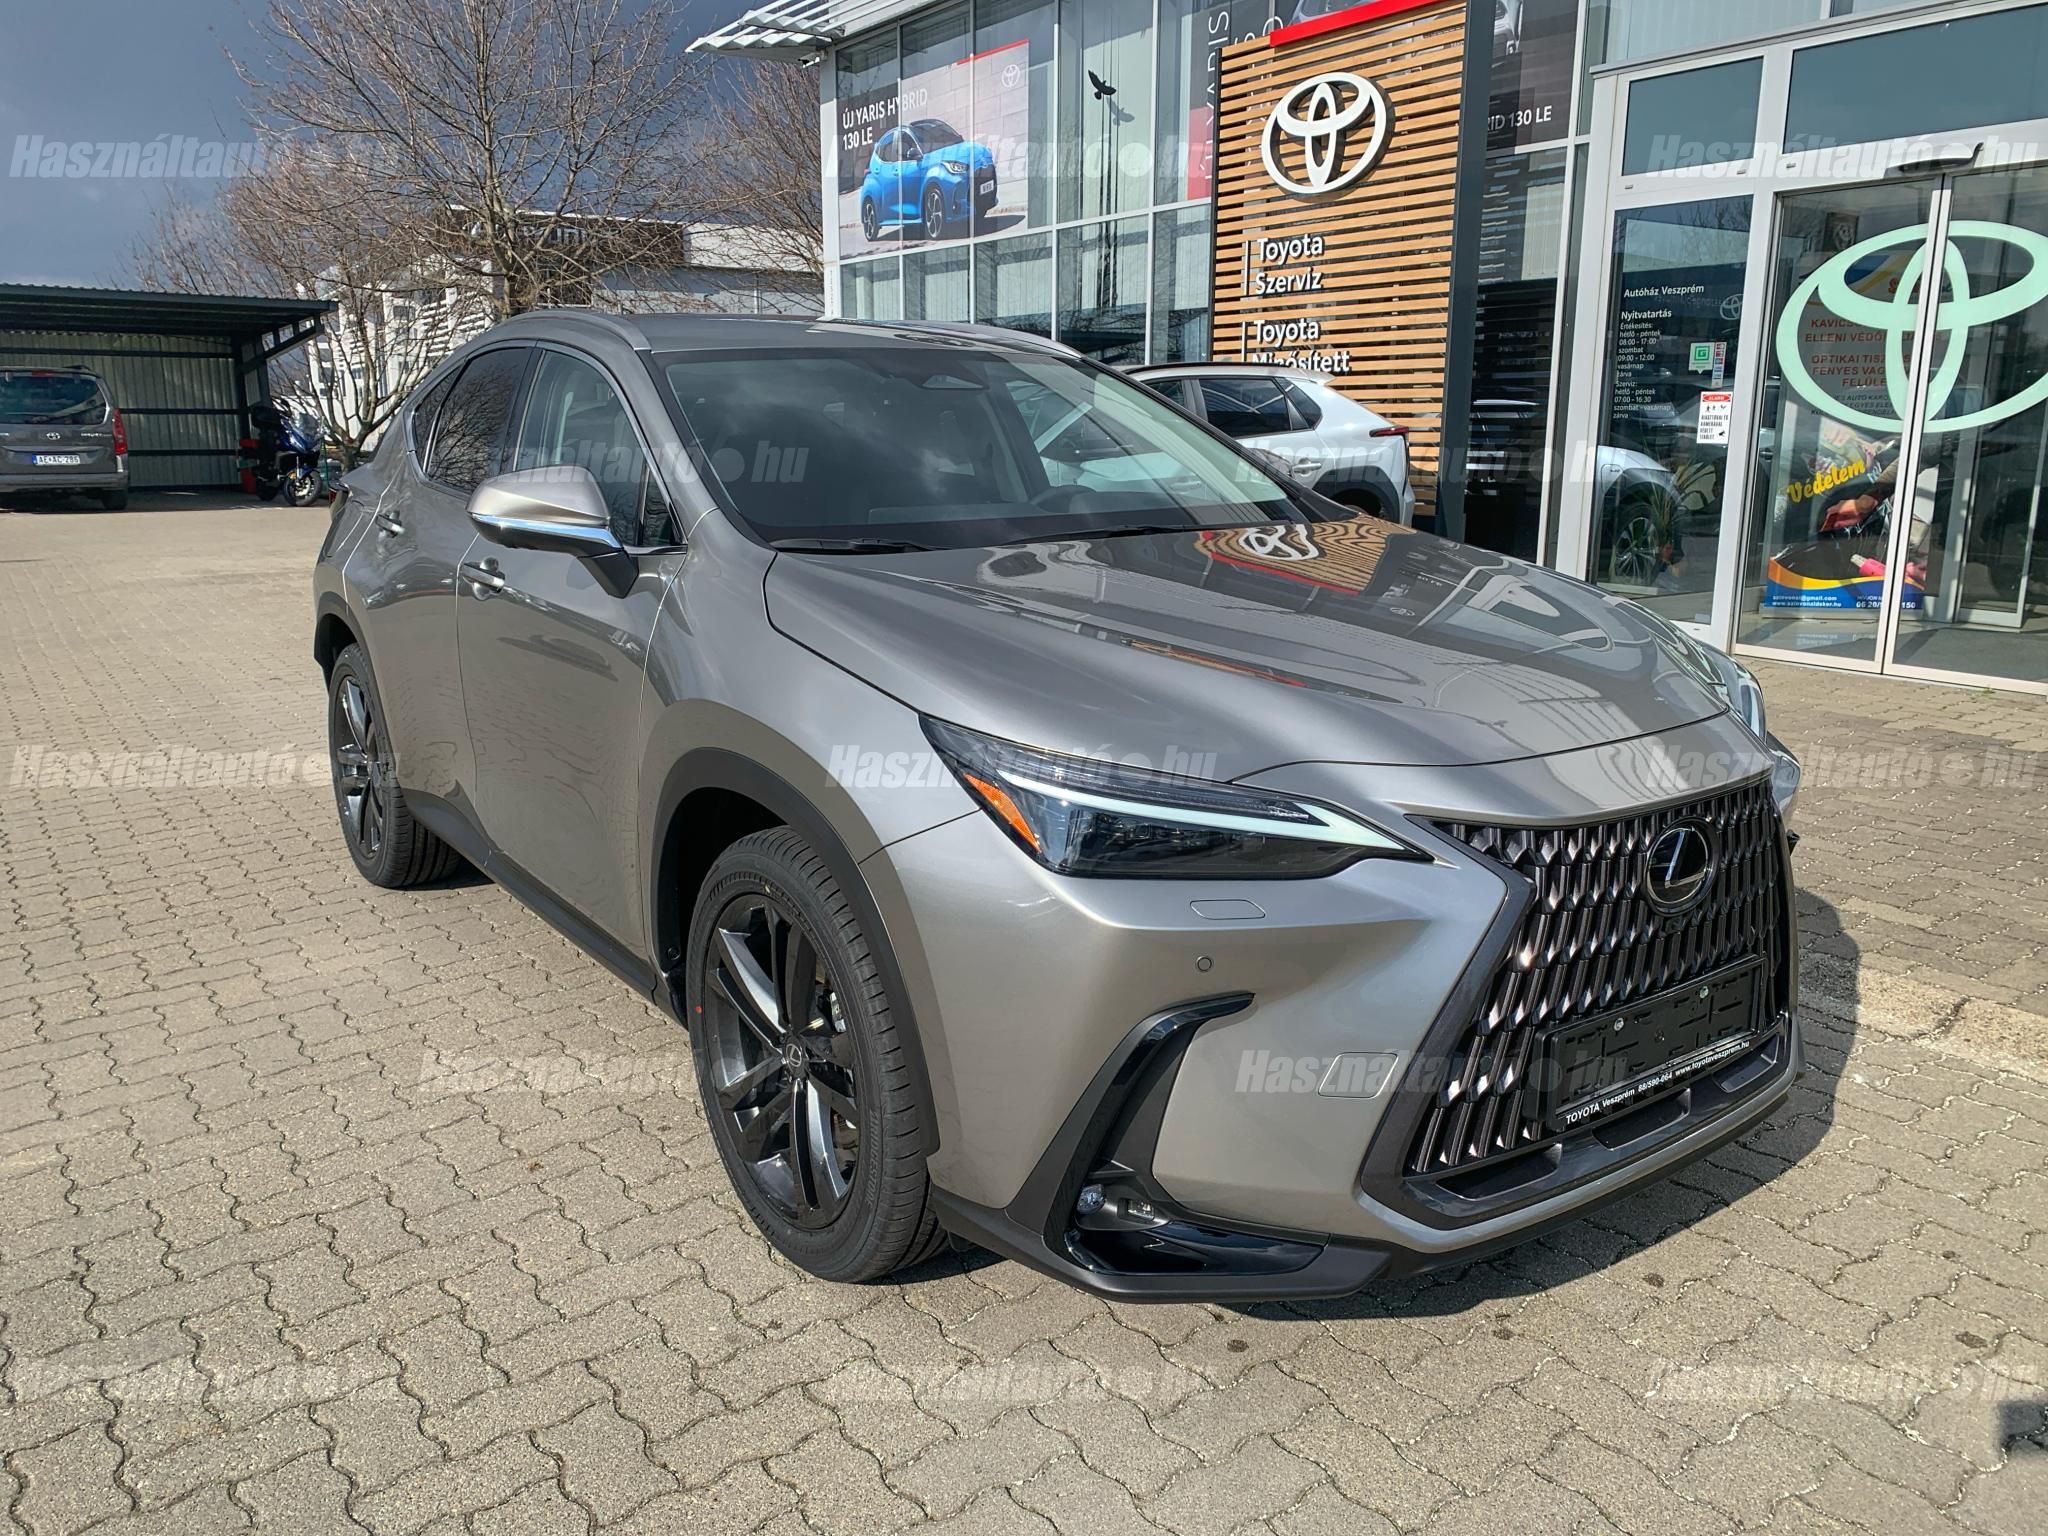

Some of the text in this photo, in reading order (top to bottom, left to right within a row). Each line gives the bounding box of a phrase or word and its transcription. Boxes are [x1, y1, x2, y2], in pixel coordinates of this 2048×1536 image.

[842, 88, 928, 129] ÚJ YARIS HYBRID
[1510, 109, 1532, 128] 130
[1536, 104, 1553, 124] LE
[843, 126, 873, 151] 130 LE
[1257, 233, 1324, 266] Toyota
[1255, 266, 1322, 295] Szerviz
[1623, 284, 1705, 298] Autóház Veszprém
[1621, 308, 1672, 321] Nyitvatartás
[1253, 318, 1320, 348] Toyota
[1618, 346, 1644, 354] szombat
[1811, 354, 1860, 365] OPTIKAI
[1786, 459, 1866, 503] Védelem
[1565, 1103, 1600, 1125] TOYOTA
[1602, 1088, 1635, 1109] Veszprém
